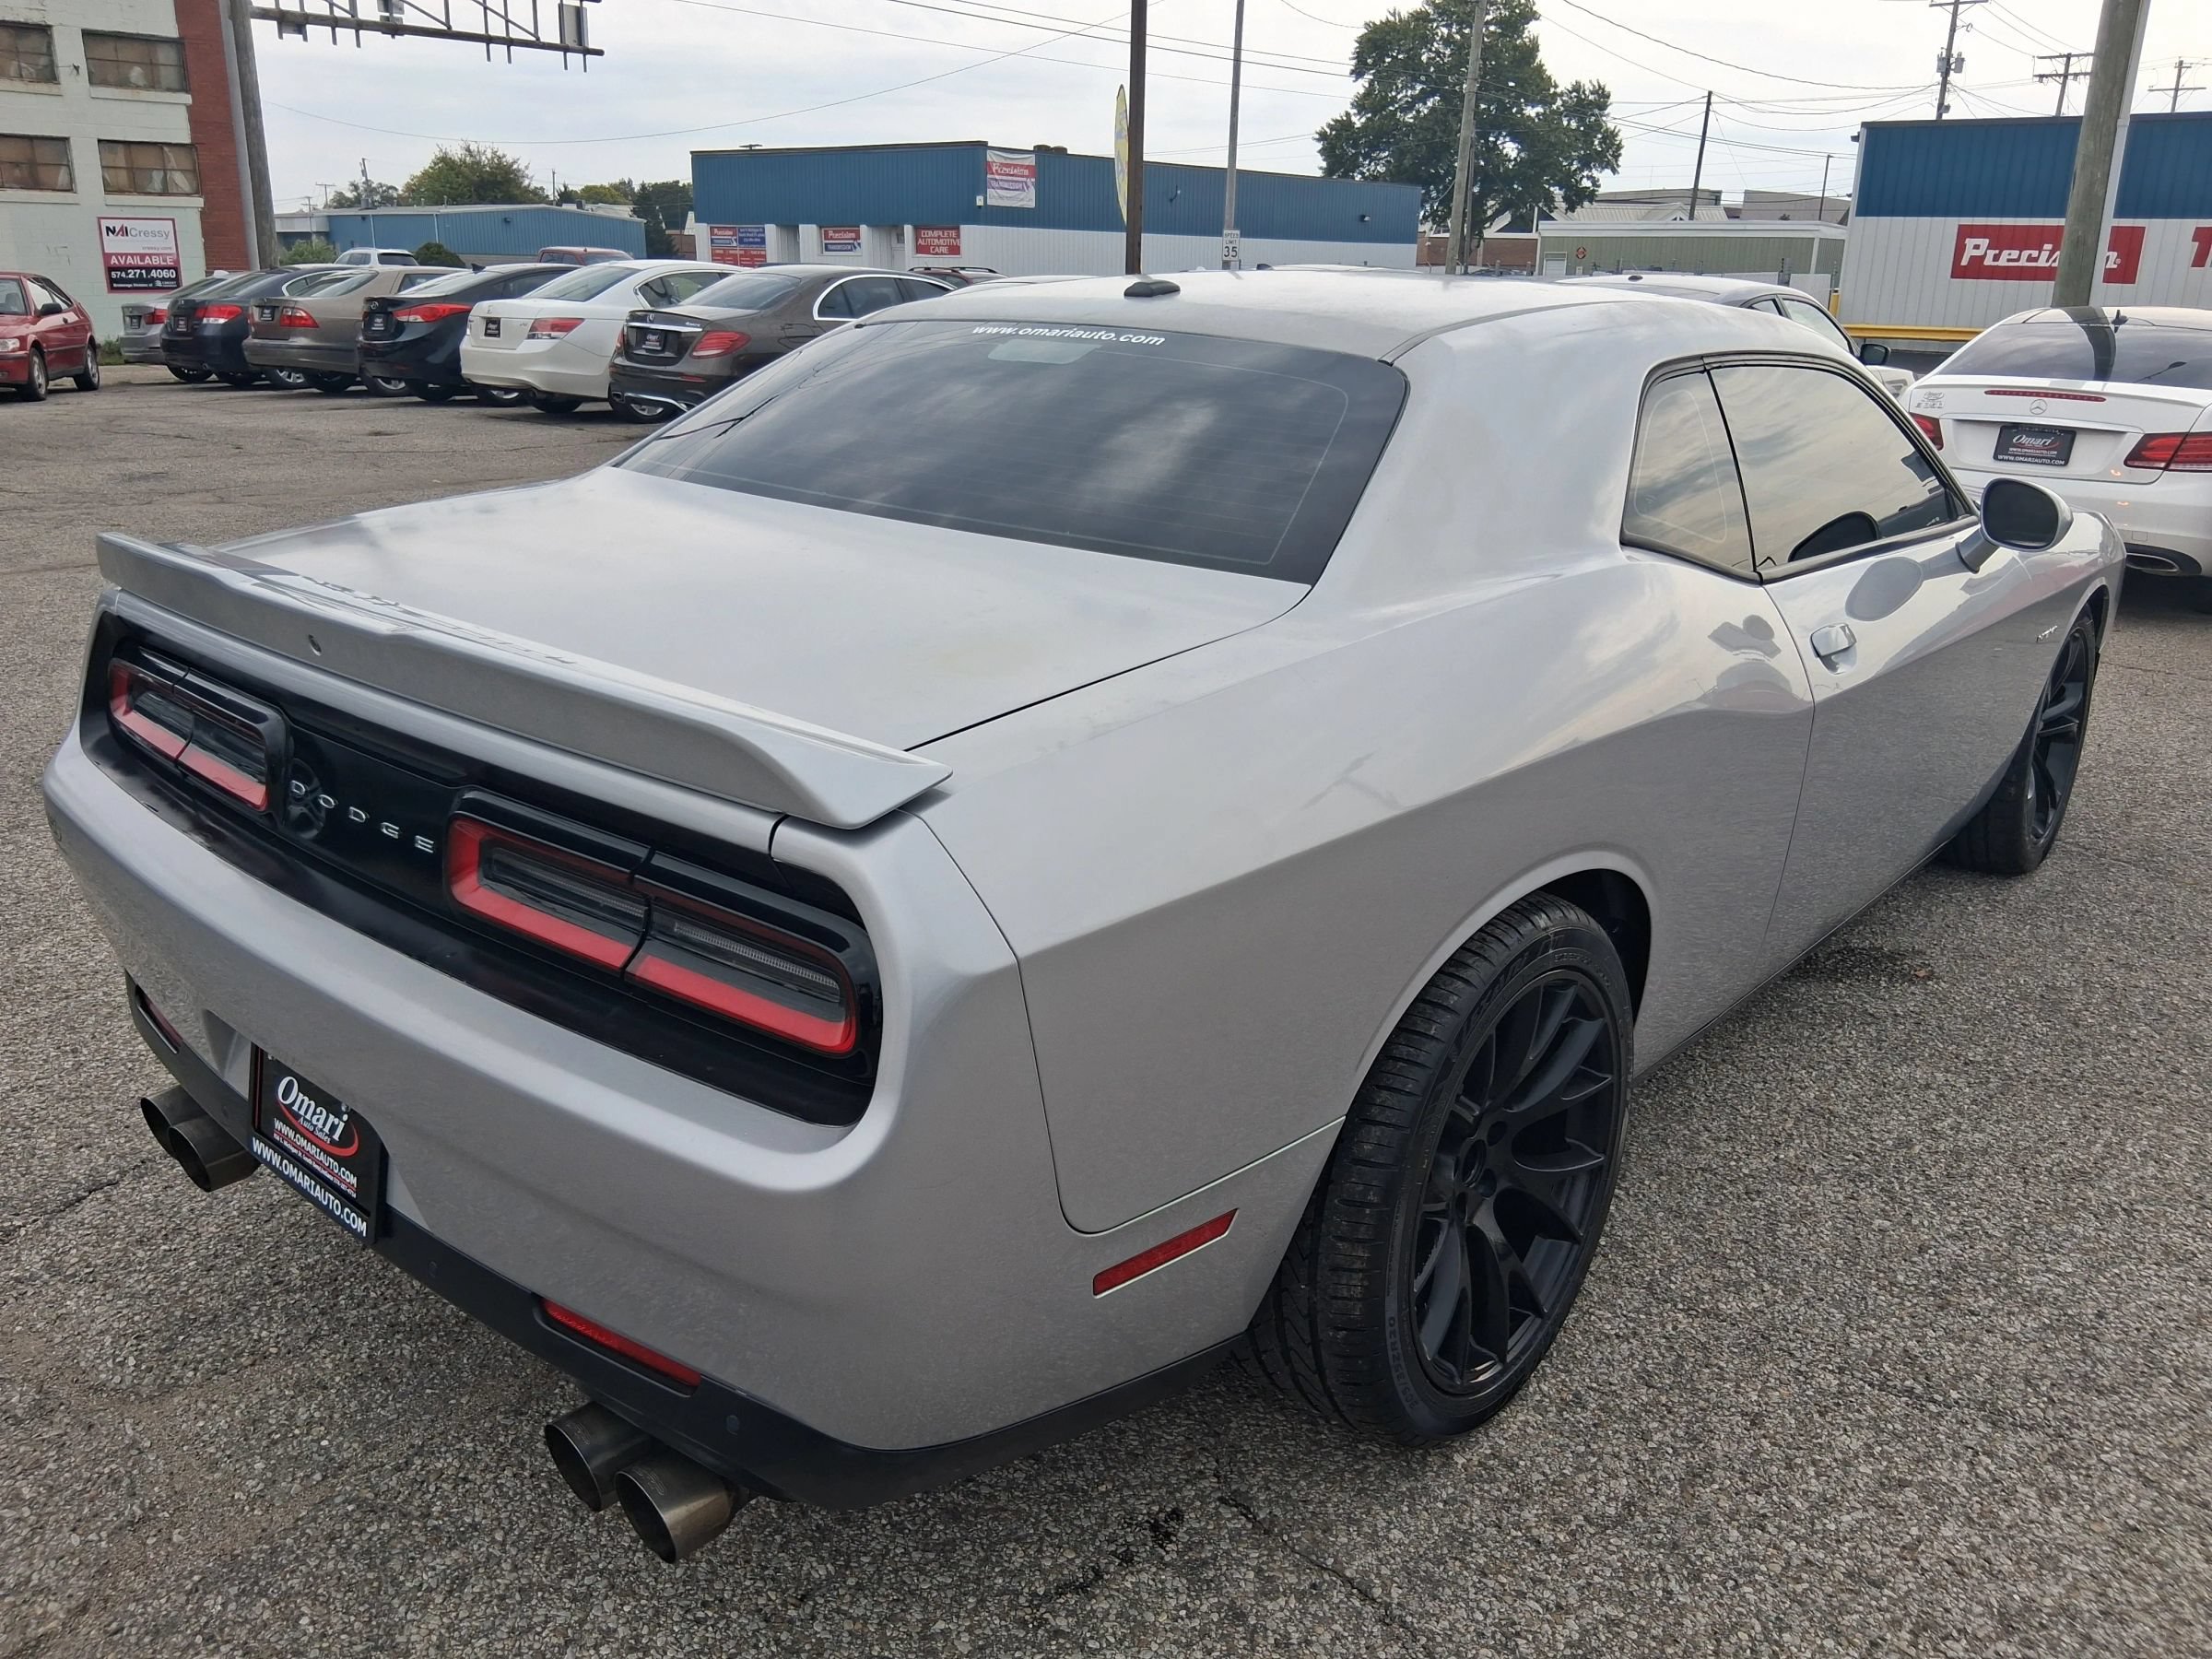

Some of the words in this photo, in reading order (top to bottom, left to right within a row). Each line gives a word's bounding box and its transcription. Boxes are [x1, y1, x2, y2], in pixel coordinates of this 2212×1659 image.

[105, 223, 129, 237] NAI
[129, 227, 170, 240] Cressy
[921, 229, 959, 238] COMPLETE
[917, 238, 961, 246] AUTOMOTIVE
[930, 245, 949, 253] CARE
[1224, 245, 1238, 258] 35
[111, 255, 174, 265] AVAILABLE
[111, 269, 176, 278] 574.271.4060
[972, 326, 1166, 346] www.omariauto.com
[2013, 434, 2055, 446] Omari
[1997, 454, 2065, 465] WWW.OMARIAUTO.COM
[290, 780, 435, 853] DODGE
[277, 1076, 348, 1142] Omari
[298, 1116, 314, 1132] Auto
[314, 1126, 332, 1144] Sales
[274, 1117, 358, 1189] WWW.OMARIAUTO.COM
[253, 1136, 368, 1237] WWW.OMARIAUTO.COM
